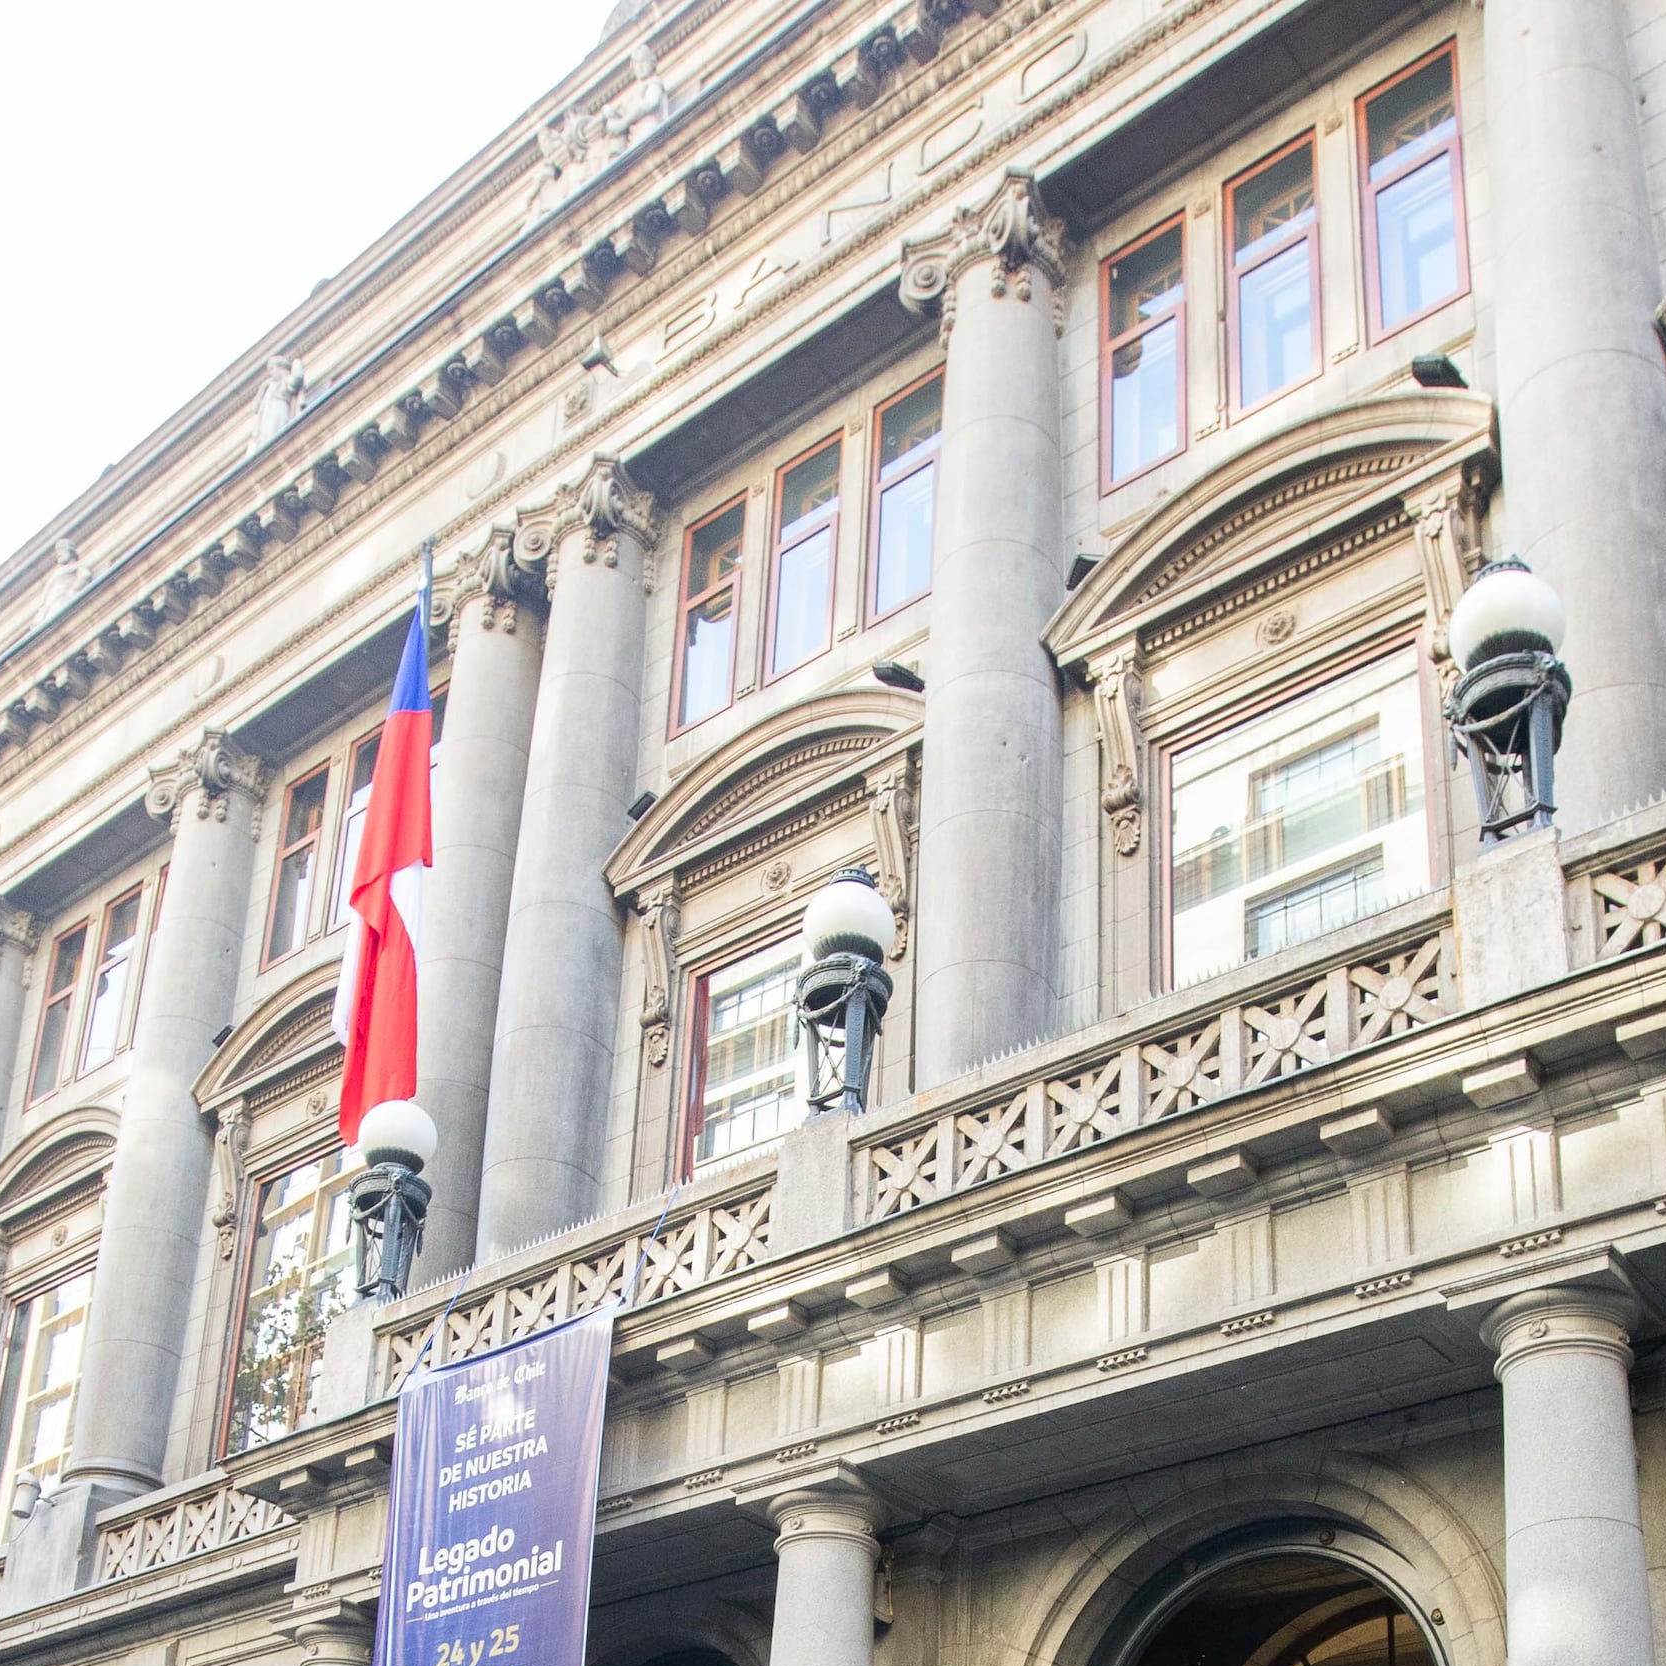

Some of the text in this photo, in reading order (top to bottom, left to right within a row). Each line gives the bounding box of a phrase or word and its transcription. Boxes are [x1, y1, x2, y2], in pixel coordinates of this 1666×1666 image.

[454, 1361, 546, 1404] Banco de Chile
[455, 1409, 535, 1453] SÉ PARTE
[439, 1435, 547, 1487] DE NUESTRA
[448, 1470, 532, 1513] HISTORIA
[418, 1525, 514, 1577] Legado
[406, 1540, 563, 1612] Patrimonial
[489, 1624, 519, 1657] 25
